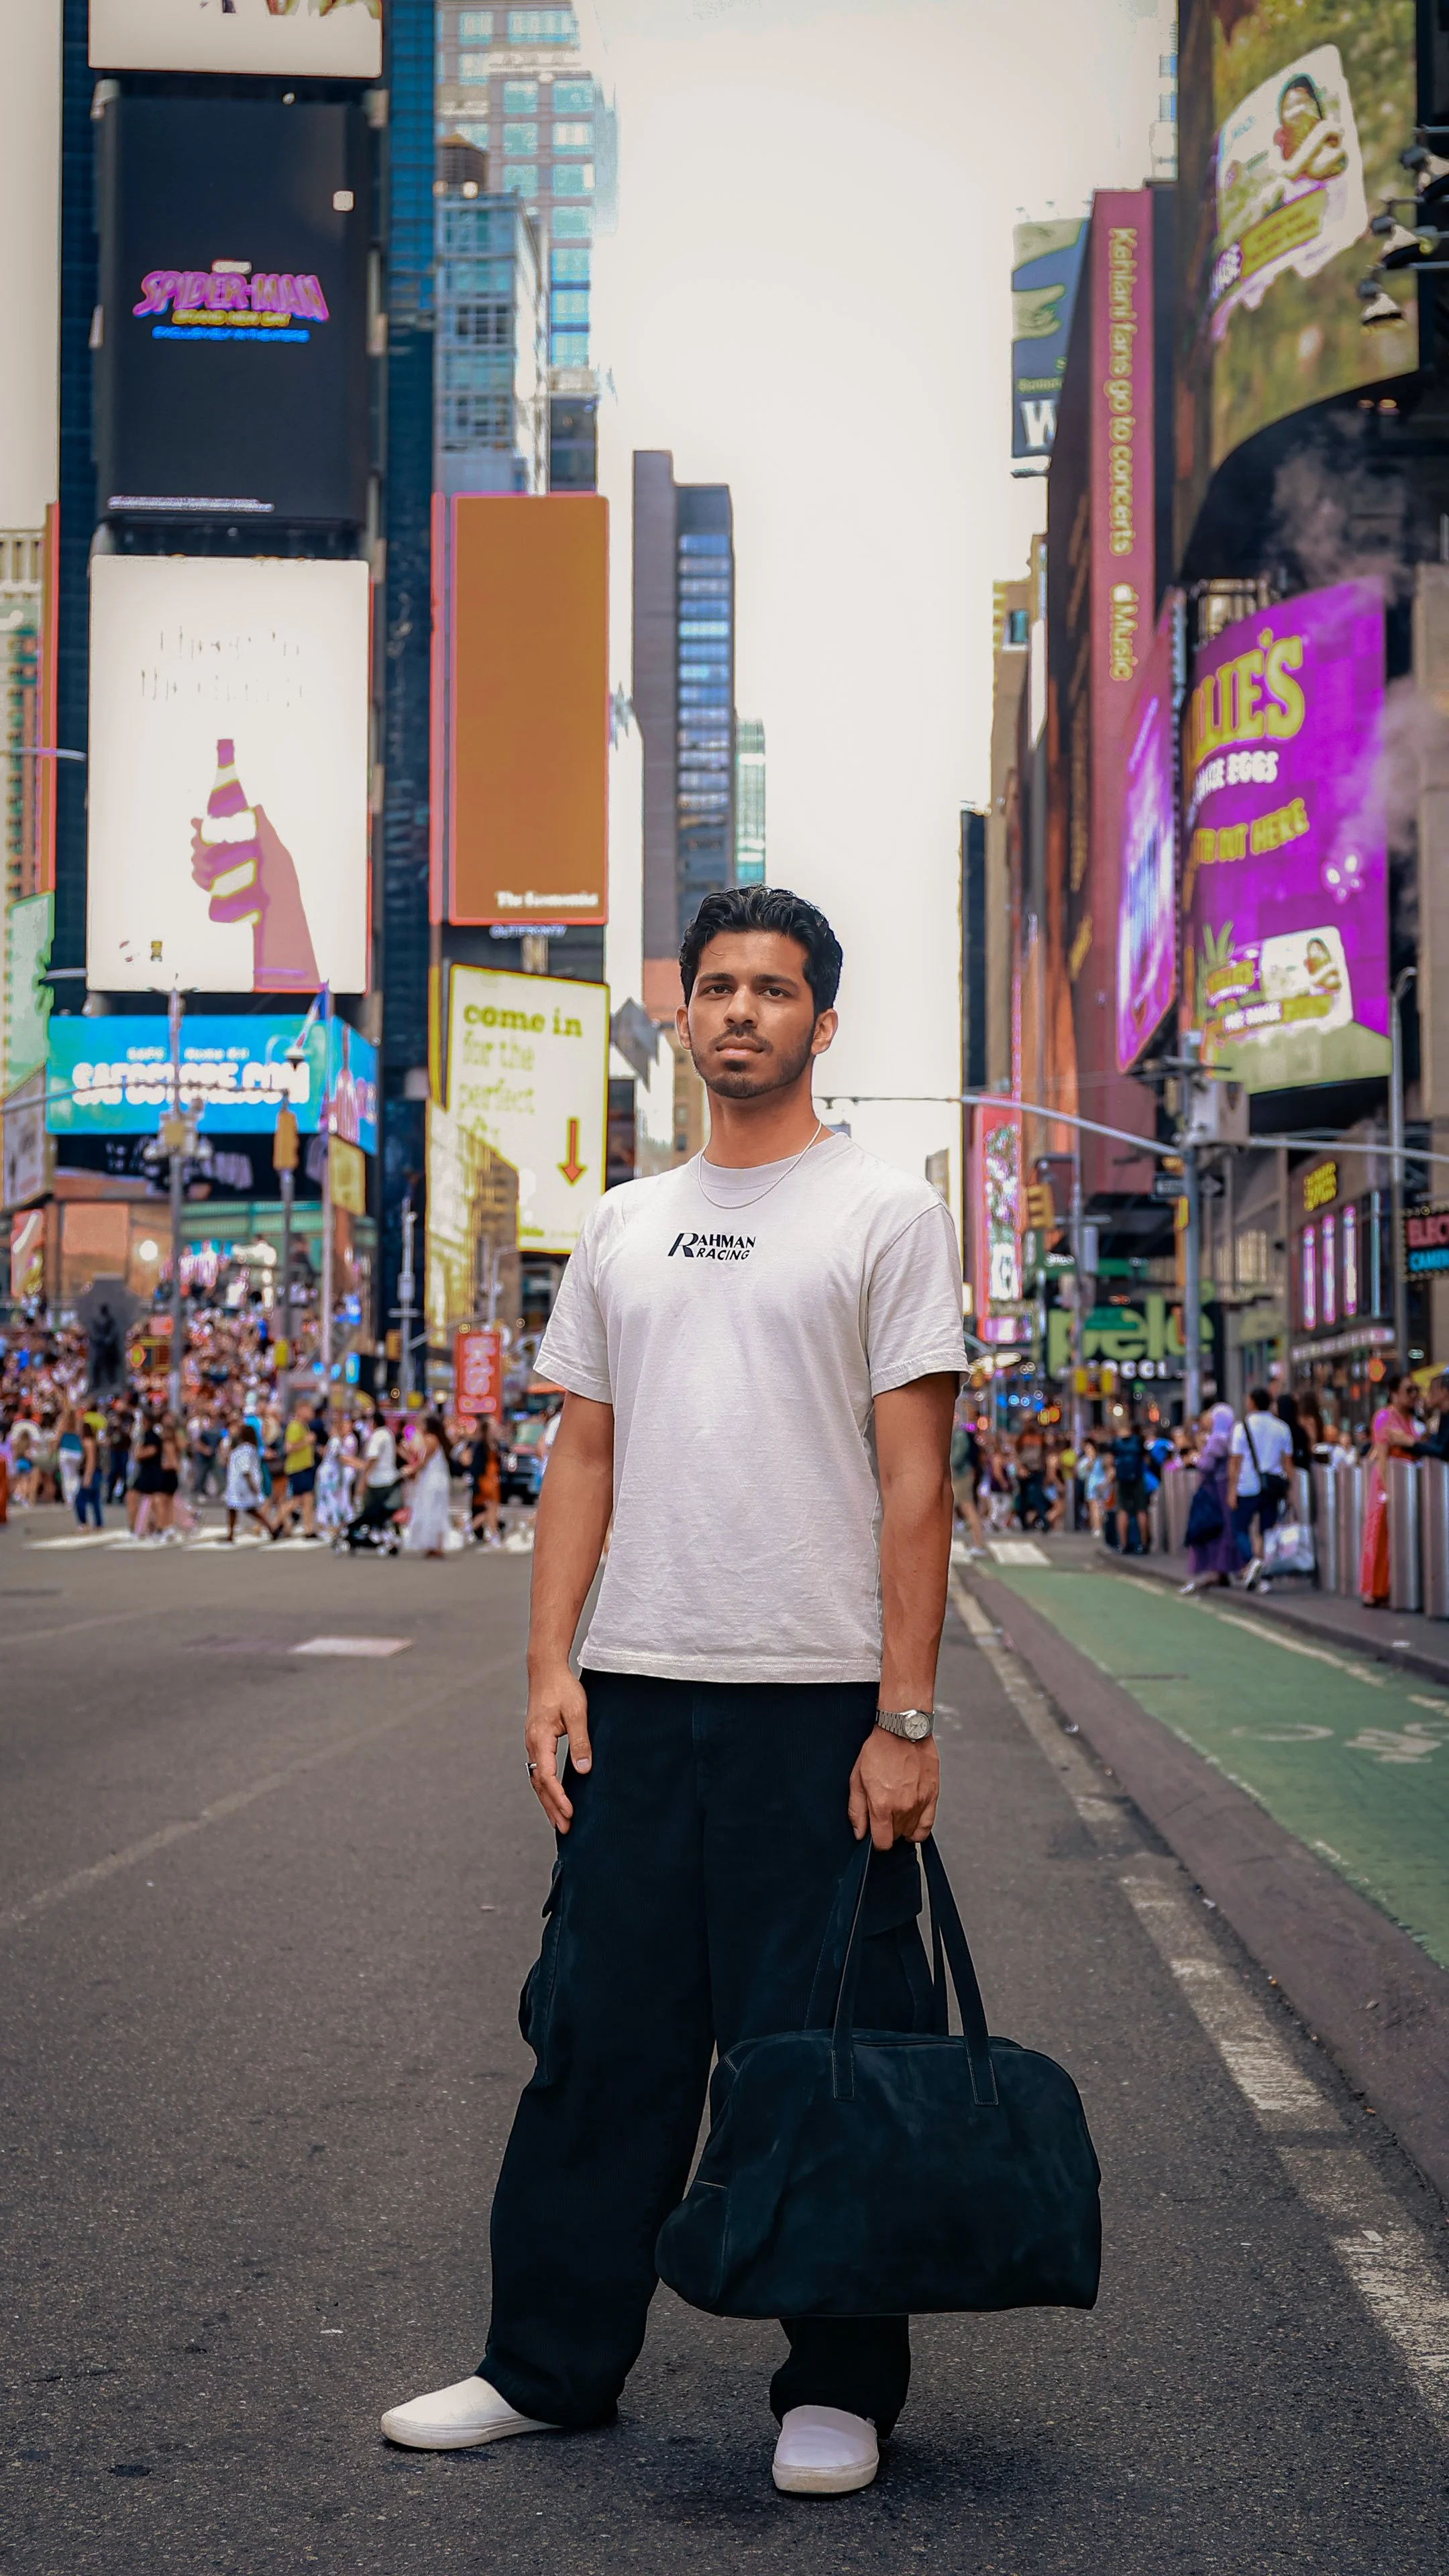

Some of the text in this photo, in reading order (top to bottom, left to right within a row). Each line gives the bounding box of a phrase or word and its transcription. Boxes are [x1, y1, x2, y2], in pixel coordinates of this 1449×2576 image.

[464, 1005, 583, 1038] come in
[667, 1233, 756, 1257] RAHMAN
[696, 1248, 750, 1260] RACING
